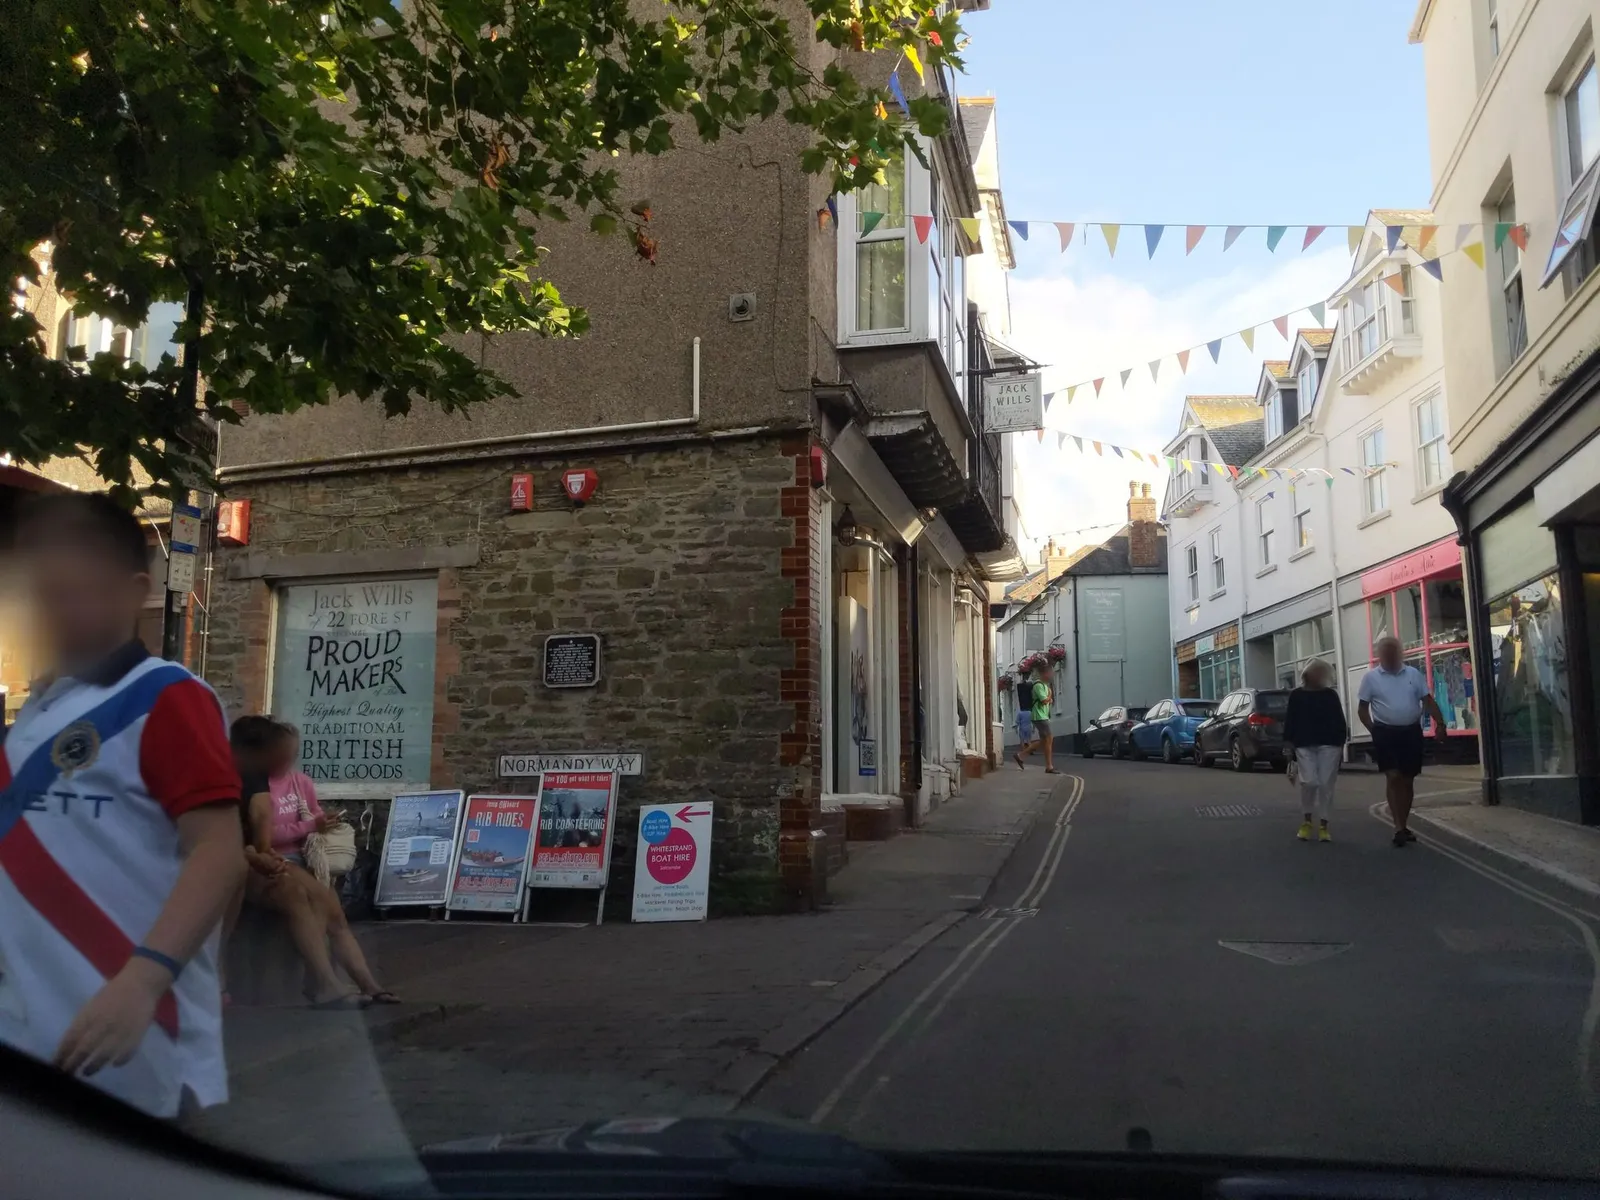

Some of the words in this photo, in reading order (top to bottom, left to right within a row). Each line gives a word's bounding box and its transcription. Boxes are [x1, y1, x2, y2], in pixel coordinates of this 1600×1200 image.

[999, 383, 1027, 395] JACK
[996, 394, 1031, 407] WILLS
[308, 589, 353, 617] Jack
[362, 584, 413, 607] Wills
[326, 610, 345, 628] 22
[350, 612, 388, 626] FORE
[393, 610, 412, 624] ST
[305, 629, 402, 672] PROUD
[309, 656, 407, 697] MAKERS
[302, 700, 352, 723] Highest
[356, 700, 404, 722] Quality
[302, 722, 405, 735] TRADITIONAL
[301, 738, 404, 760] BRITISH
[302, 763, 340, 780] FINE
[344, 763, 403, 780] GOODS
[503, 757, 597, 773] NORMANDY
[600, 757, 636, 772] WAY
[475, 811, 493, 828] RIB
[495, 811, 525, 828] RIDES
[539, 818, 553, 830] RIB
[555, 818, 606, 830] COASTEERING
[650, 844, 693, 853] WHITESTRAND
[651, 854, 671, 863] BOAT
[673, 853, 691, 862] HIRE
